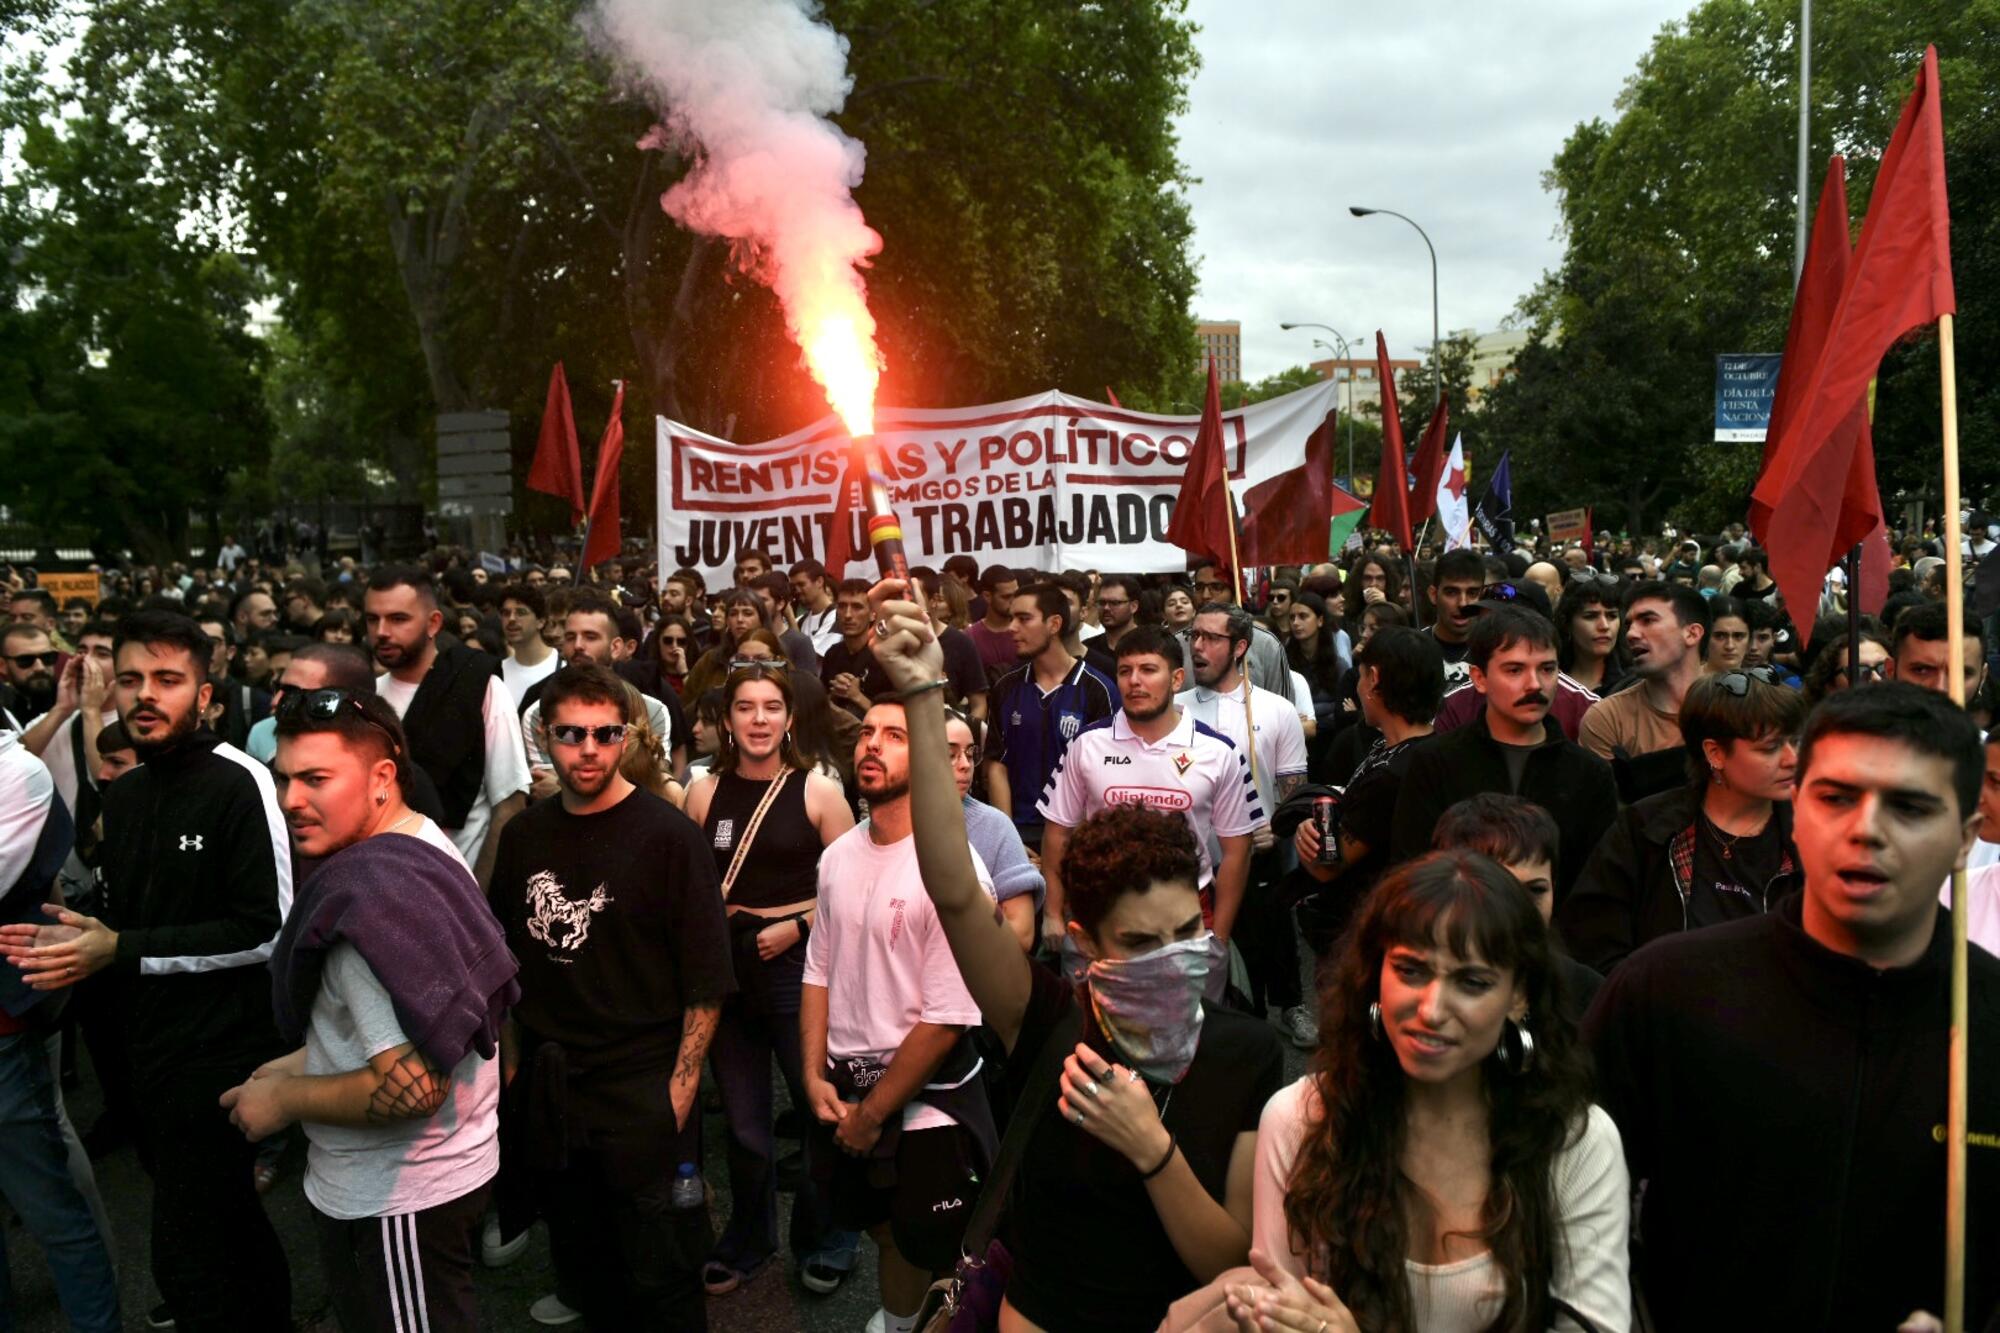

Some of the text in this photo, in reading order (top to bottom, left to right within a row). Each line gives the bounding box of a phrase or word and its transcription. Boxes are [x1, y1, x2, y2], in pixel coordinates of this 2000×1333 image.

[1724, 372, 1769, 380] OCTUBRE
[1723, 388, 1743, 397] DÍA
[1745, 388, 1760, 397] DE
[1723, 400, 1759, 409] FIESTA
[1722, 412, 1771, 422] NACIONA
[934, 438, 967, 474] Y
[979, 418, 1195, 470] POLÍTICO
[986, 473, 1021, 496] DE
[1027, 469, 1057, 491] LA
[675, 511, 899, 567] JUVENTU
[1104, 756, 1132, 766] FILA
[1111, 791, 1184, 808] Nintendo
[932, 1198, 963, 1213] FILA
